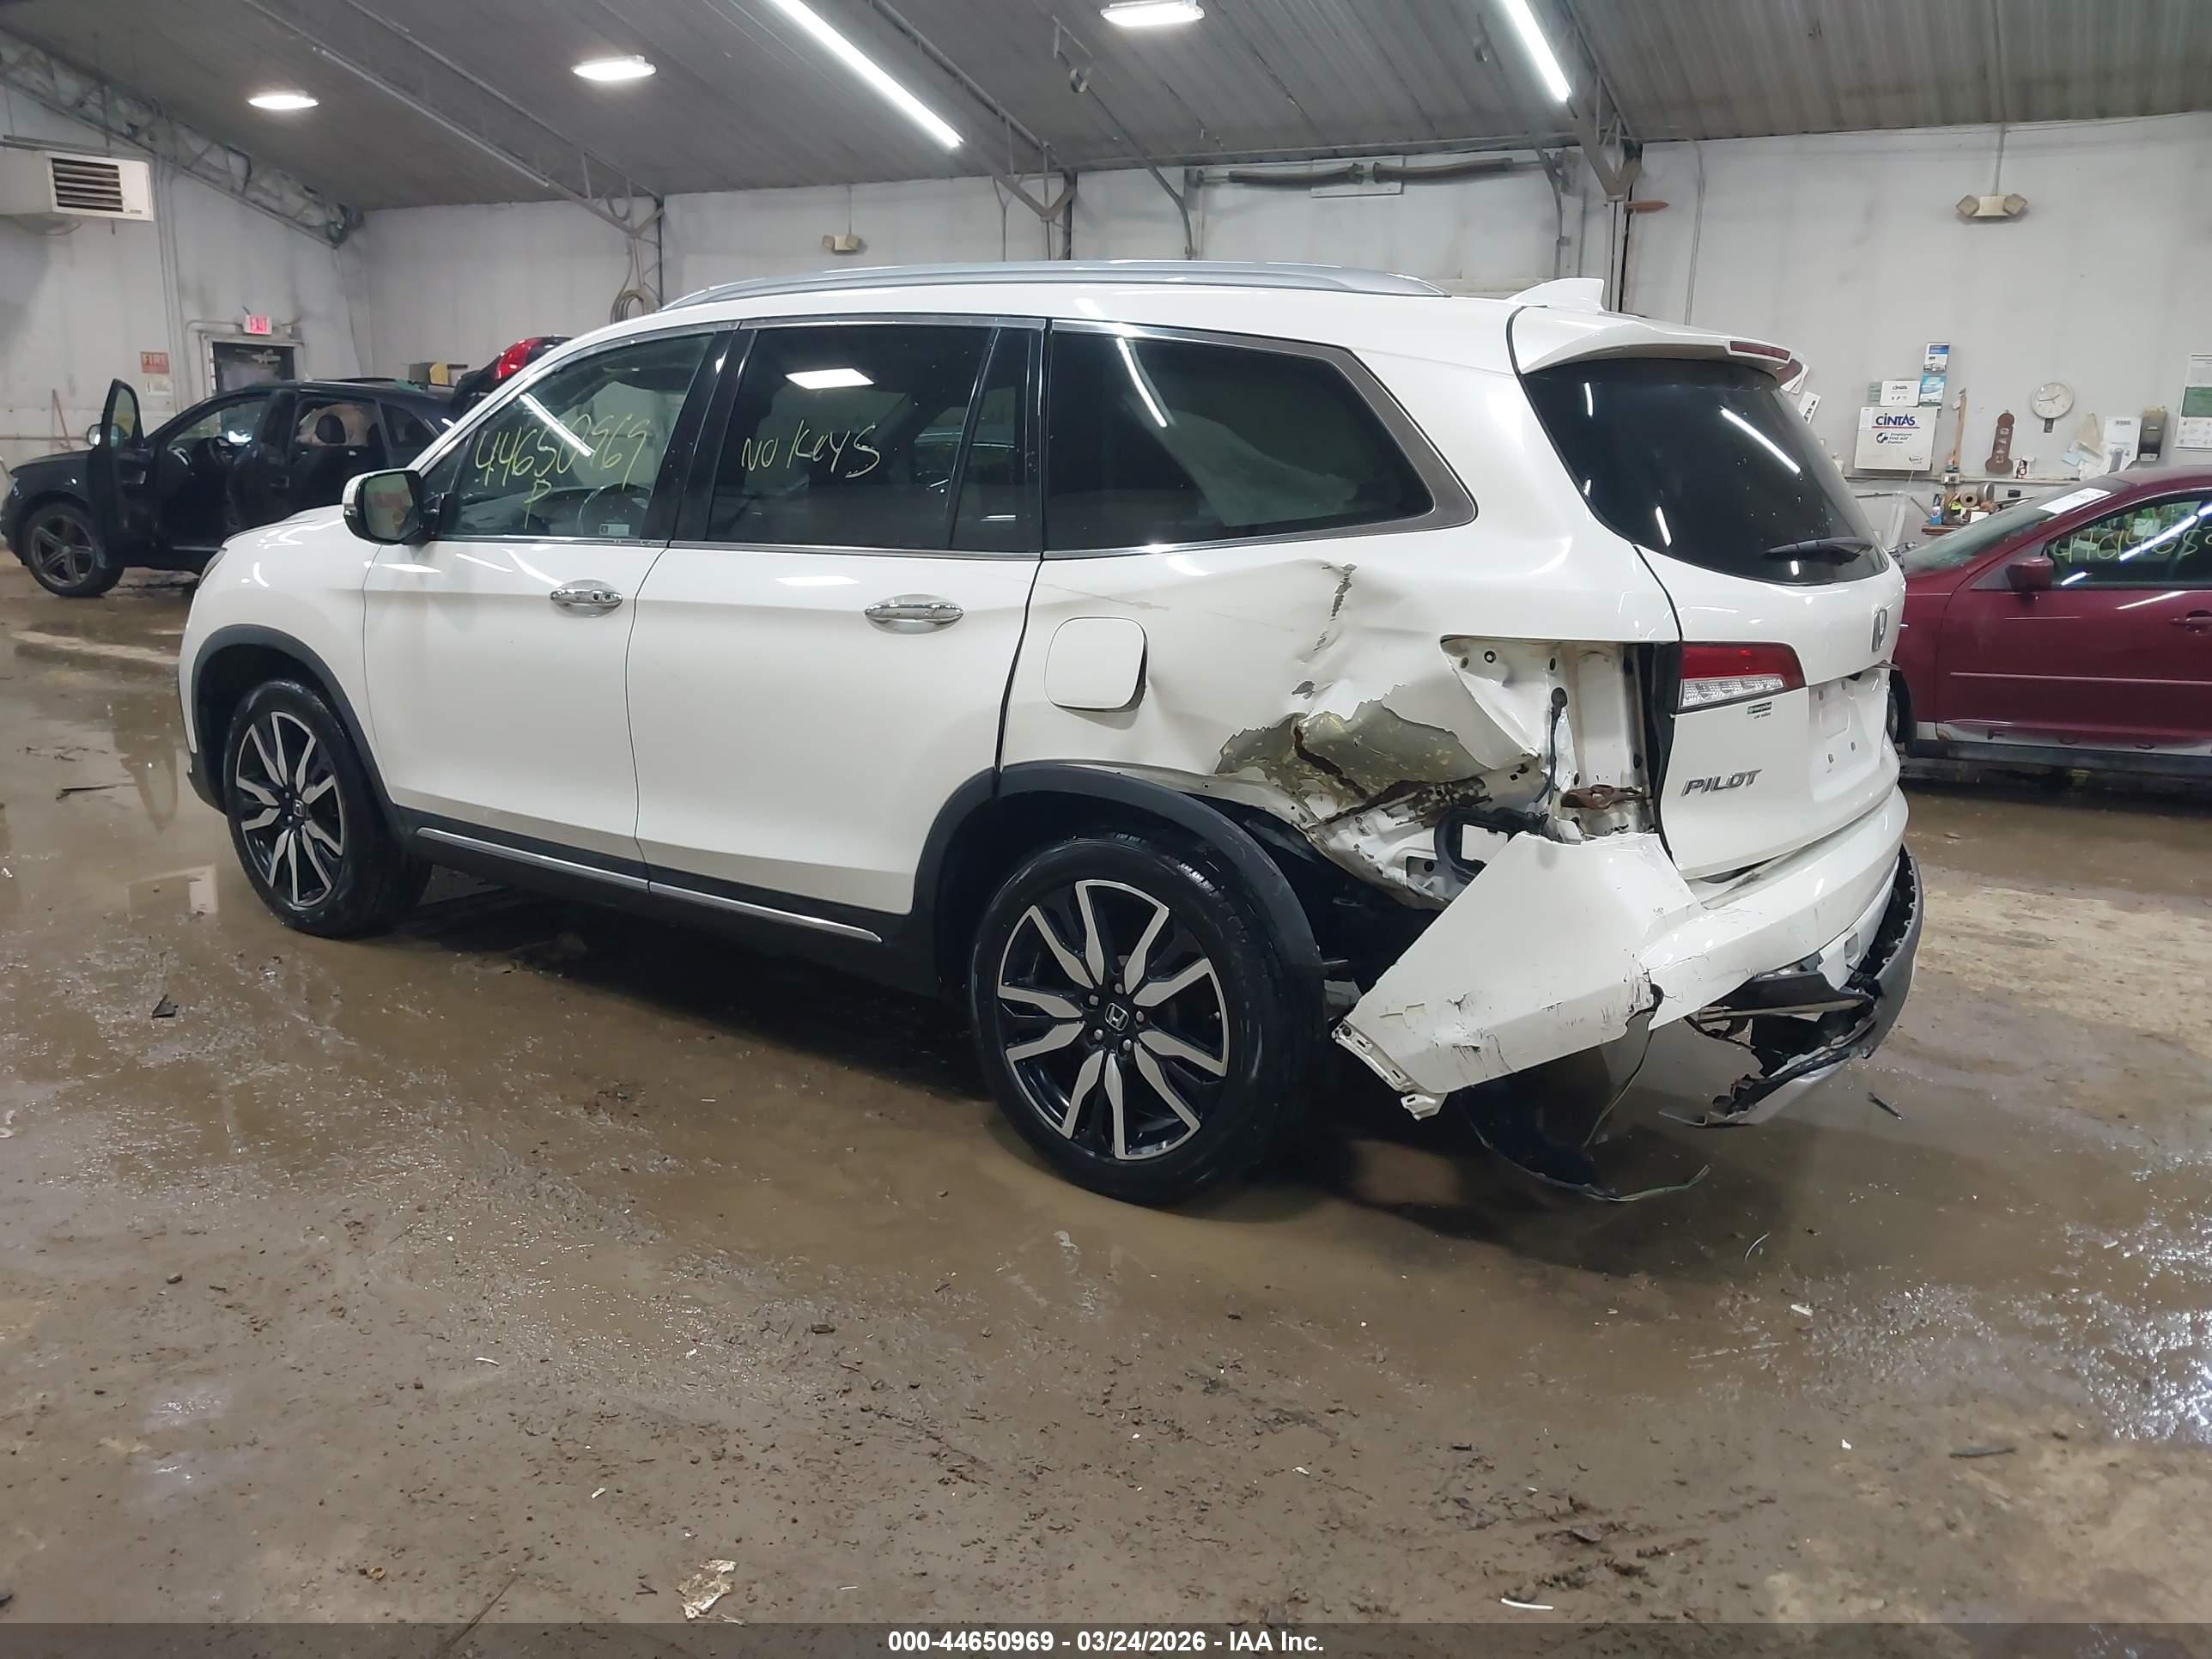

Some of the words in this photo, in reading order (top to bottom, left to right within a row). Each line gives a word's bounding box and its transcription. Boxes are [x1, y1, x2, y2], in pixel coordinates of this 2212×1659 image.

[1875, 413, 1916, 427] CINTAS
[476, 414, 651, 491] 44650969
[741, 437, 780, 472] NO
[1681, 769, 1763, 798] PILOT
